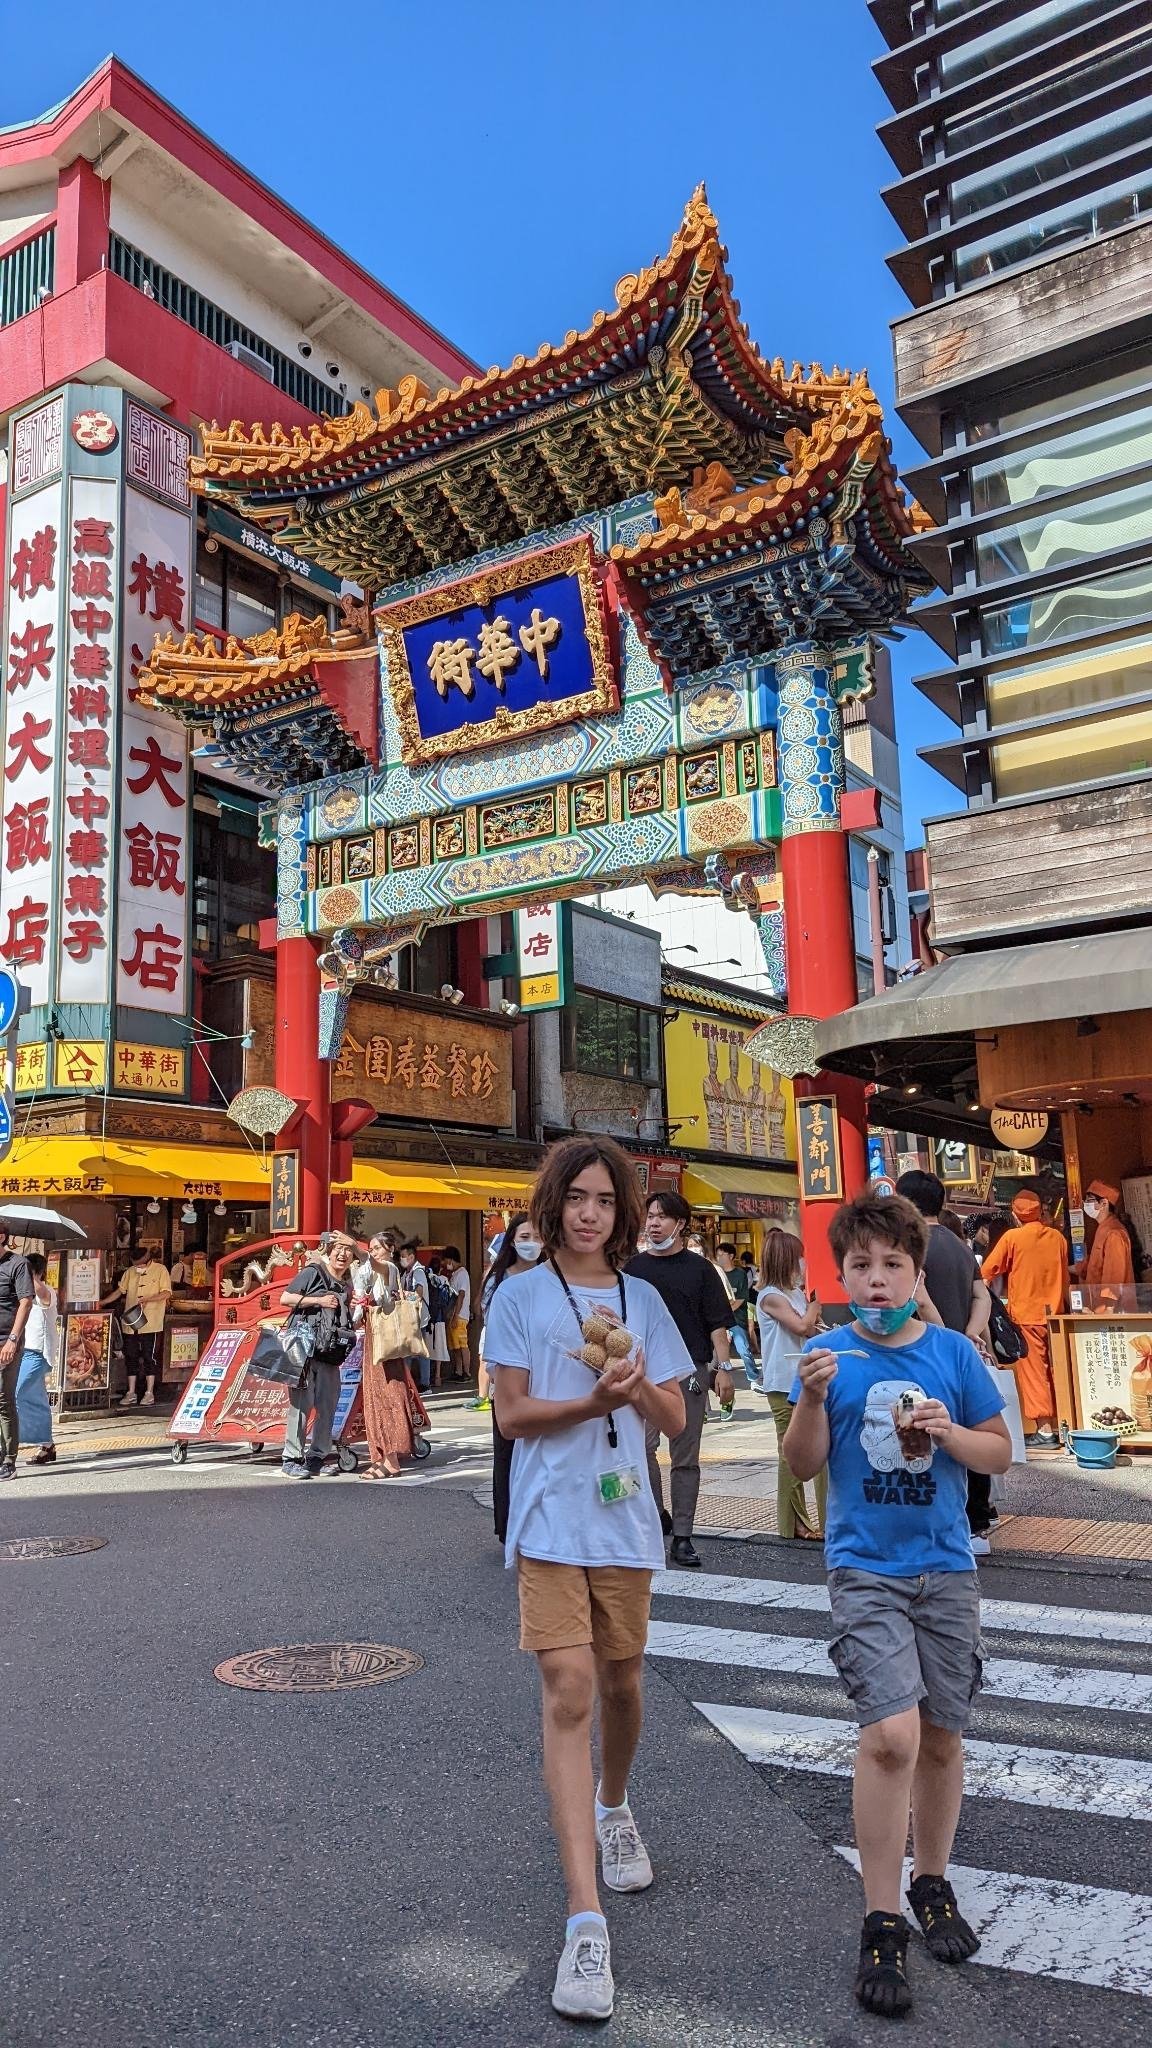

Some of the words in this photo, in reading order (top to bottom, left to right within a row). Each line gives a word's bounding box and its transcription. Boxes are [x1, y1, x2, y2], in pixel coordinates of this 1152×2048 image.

[241, 528, 311, 577] 横浜大飯店
[427, 609, 560, 696] 中華街
[120, 553, 186, 994] 横大飯店
[526, 982, 552, 997] 本店
[119, 1048, 179, 1075] 中華街
[119, 1071, 179, 1088] 大通り入口
[993, 1116, 1014, 1130] The
[1013, 1112, 1045, 1130] CAFE
[2, 1176, 107, 1193] 横浜大飯店
[863, 1468, 937, 1488] STAR
[863, 1486, 937, 1506] WARS
